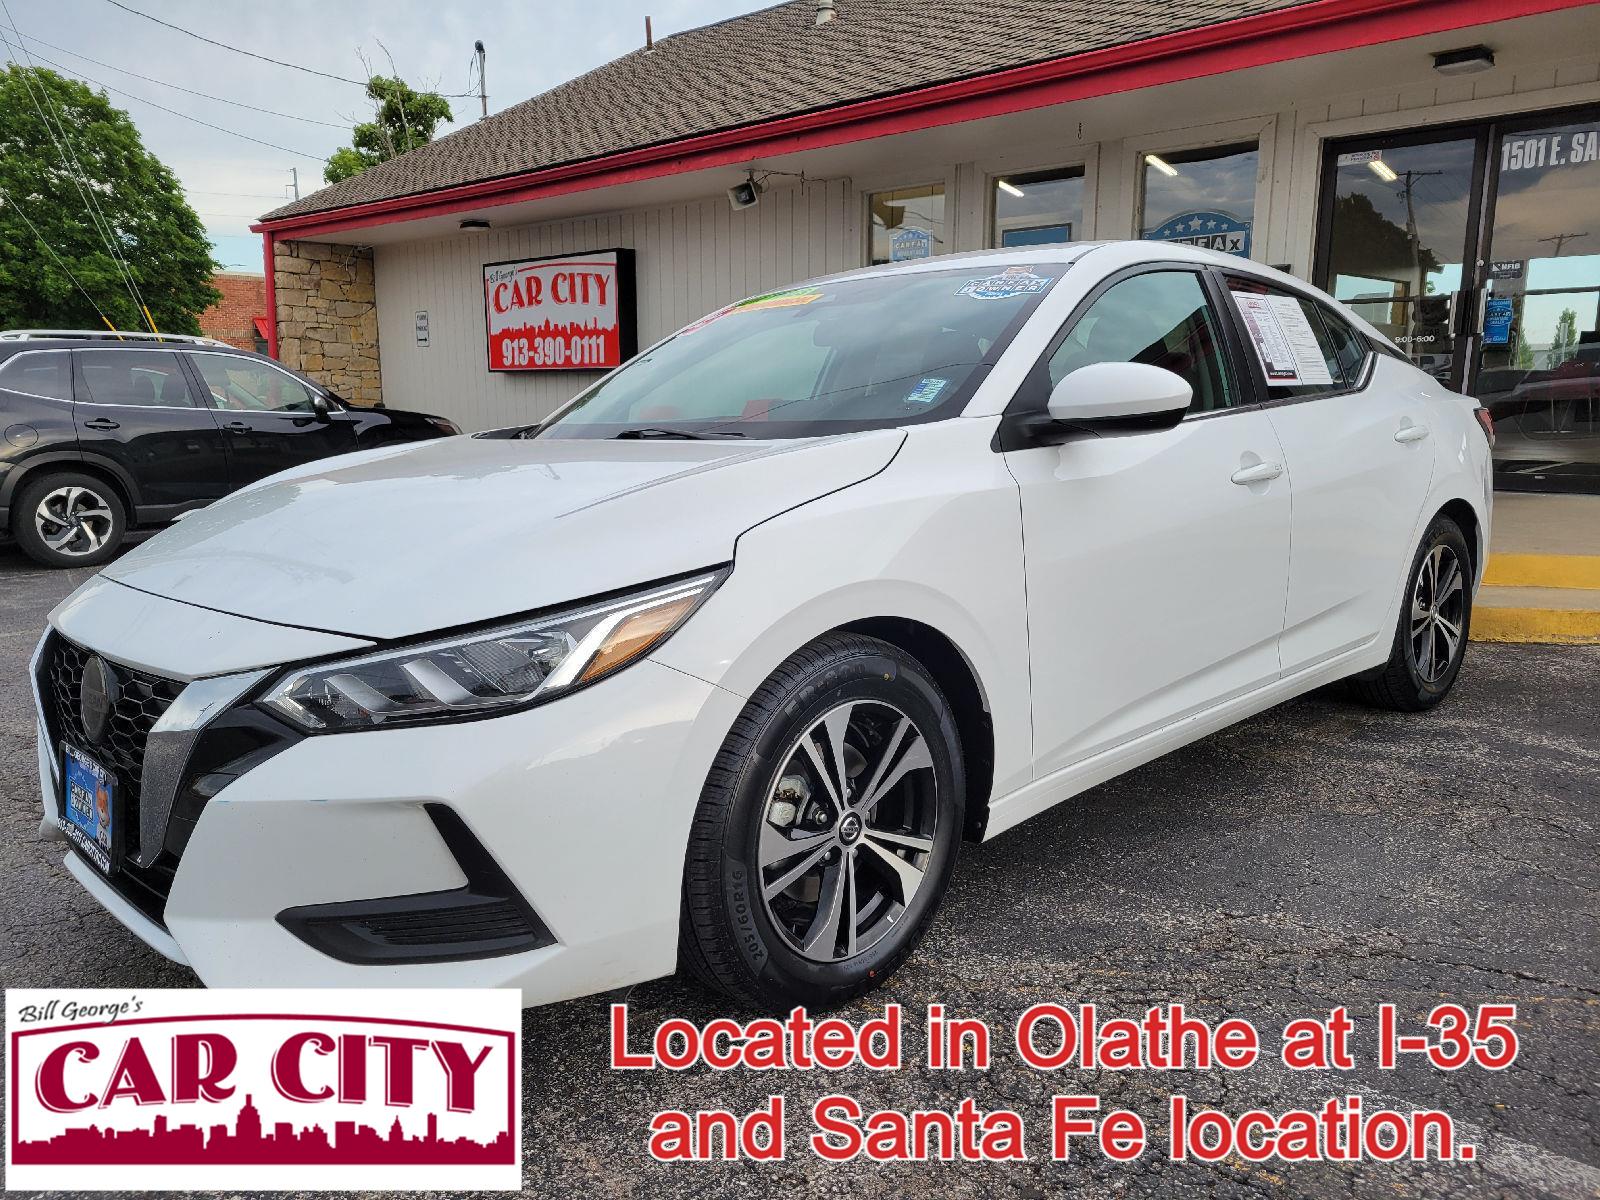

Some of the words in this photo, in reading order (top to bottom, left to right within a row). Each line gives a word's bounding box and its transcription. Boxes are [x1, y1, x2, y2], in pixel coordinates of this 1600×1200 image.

[1501, 137, 1547, 171] 1501
[1549, 135, 1566, 166] E.
[1570, 131, 1600, 163] SA
[493, 275, 543, 315] CAR
[551, 272, 610, 306] CITY
[502, 335, 605, 366] 913-390-0111
[1395, 335, 1435, 343] 9:00-6:00
